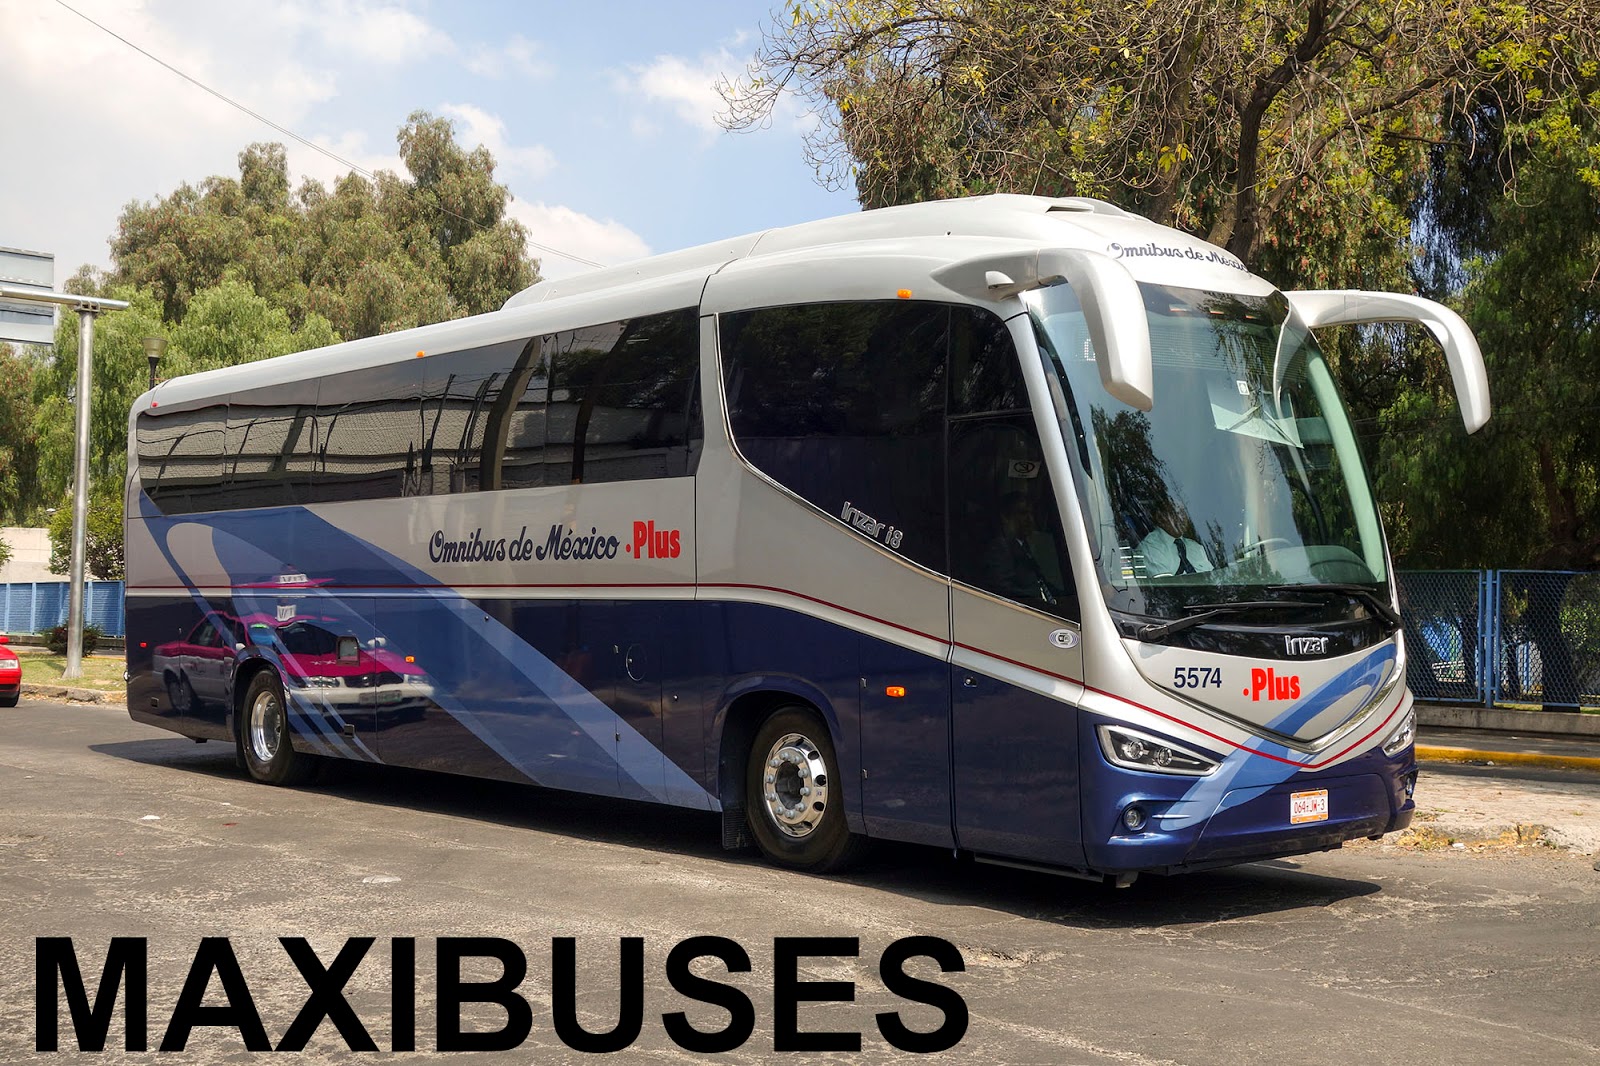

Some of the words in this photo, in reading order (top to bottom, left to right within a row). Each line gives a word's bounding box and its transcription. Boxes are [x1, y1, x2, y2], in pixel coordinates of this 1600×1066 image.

[1106, 242, 1184, 260] Omnibus
[1185, 247, 1204, 260] de
[1205, 250, 1249, 273] Méxic
[428, 527, 506, 563] Omnibus
[508, 526, 534, 562] de
[535, 524, 620, 561] México
[885, 526, 903, 549] i8
[1173, 667, 1222, 689] 5574
